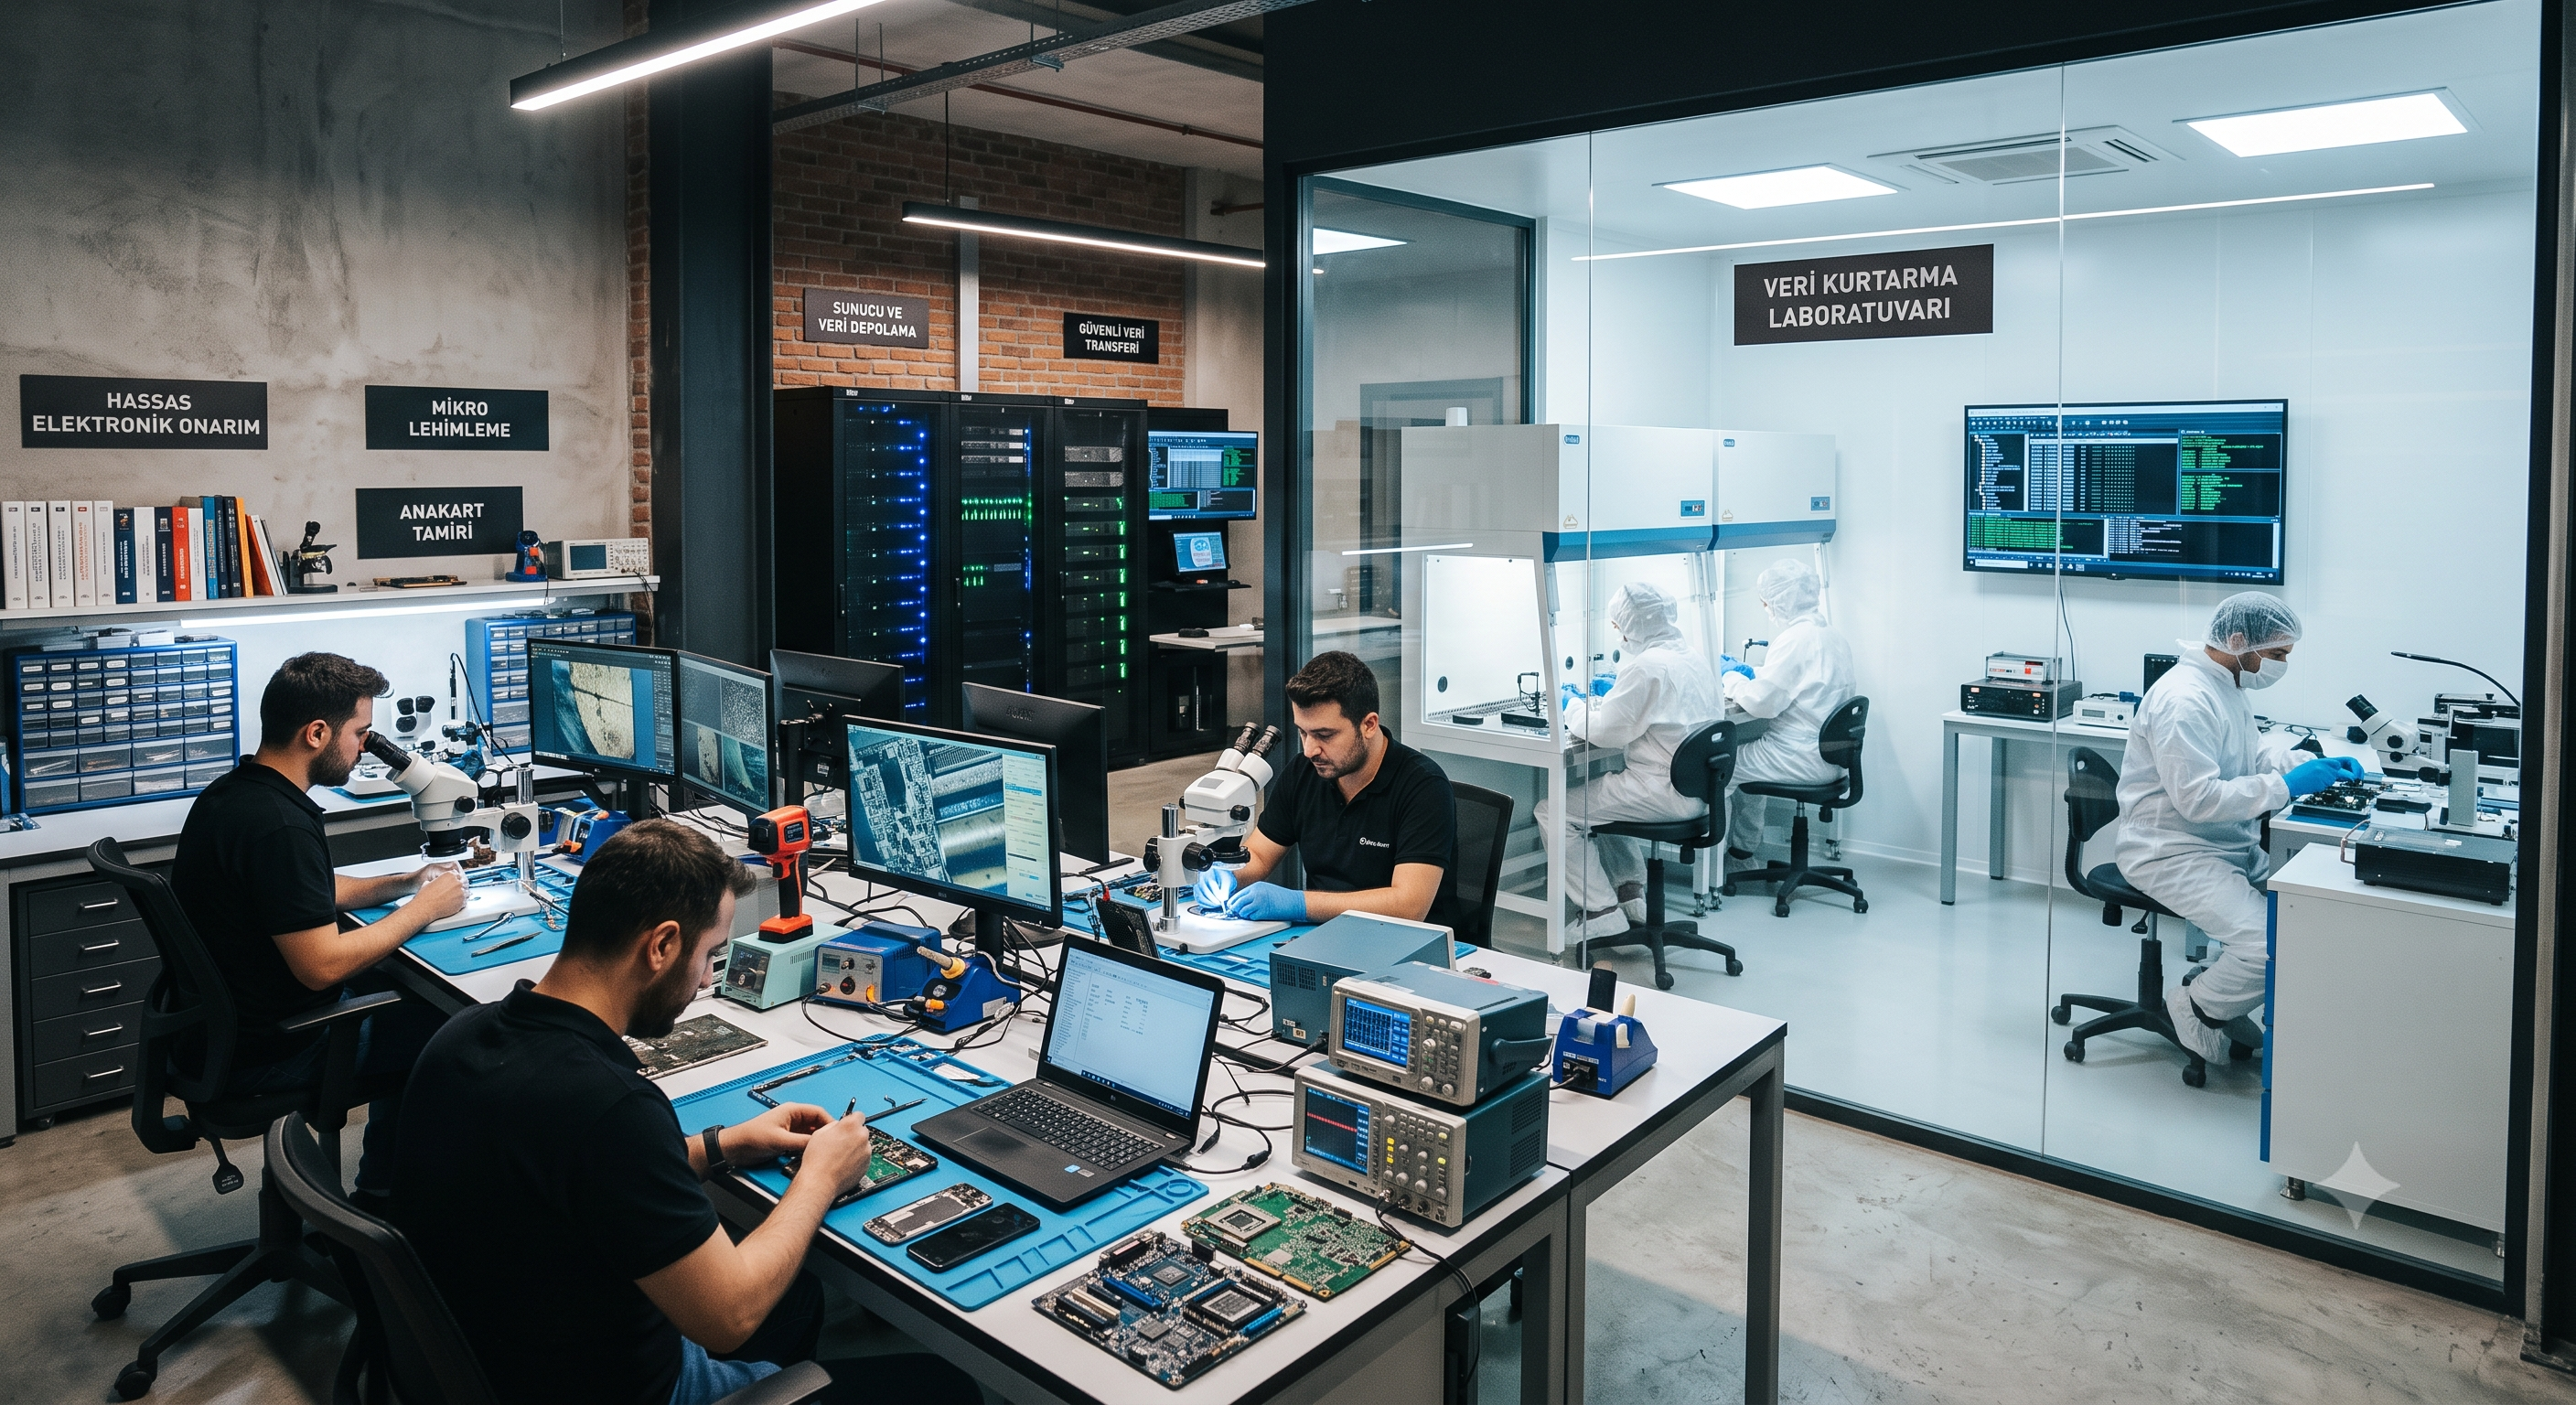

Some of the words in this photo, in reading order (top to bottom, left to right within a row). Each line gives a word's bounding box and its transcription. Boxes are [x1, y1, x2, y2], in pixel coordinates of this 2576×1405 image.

[1763, 271, 1815, 298] VERİ
[1823, 264, 1959, 295] KURTARMA
[832, 301, 885, 317] SUNUCU
[886, 306, 903, 320] VE
[1769, 296, 1950, 328] LABORATUVARI
[818, 316, 847, 334] VERİ
[850, 320, 918, 338] DEPOLAMA
[1079, 320, 1122, 338] GÜVENLİ
[1122, 326, 1144, 339] VERİ
[1084, 338, 1140, 354] TRANSFERİ
[107, 391, 192, 411] HASSAS
[432, 396, 488, 416] MİKRO
[32, 413, 174, 434] ELEKTRONİK
[178, 417, 260, 435] ONARIM
[409, 418, 511, 438] LEHİMLEME
[399, 502, 485, 520] ANAKART
[412, 520, 473, 542] TAMİRİ
